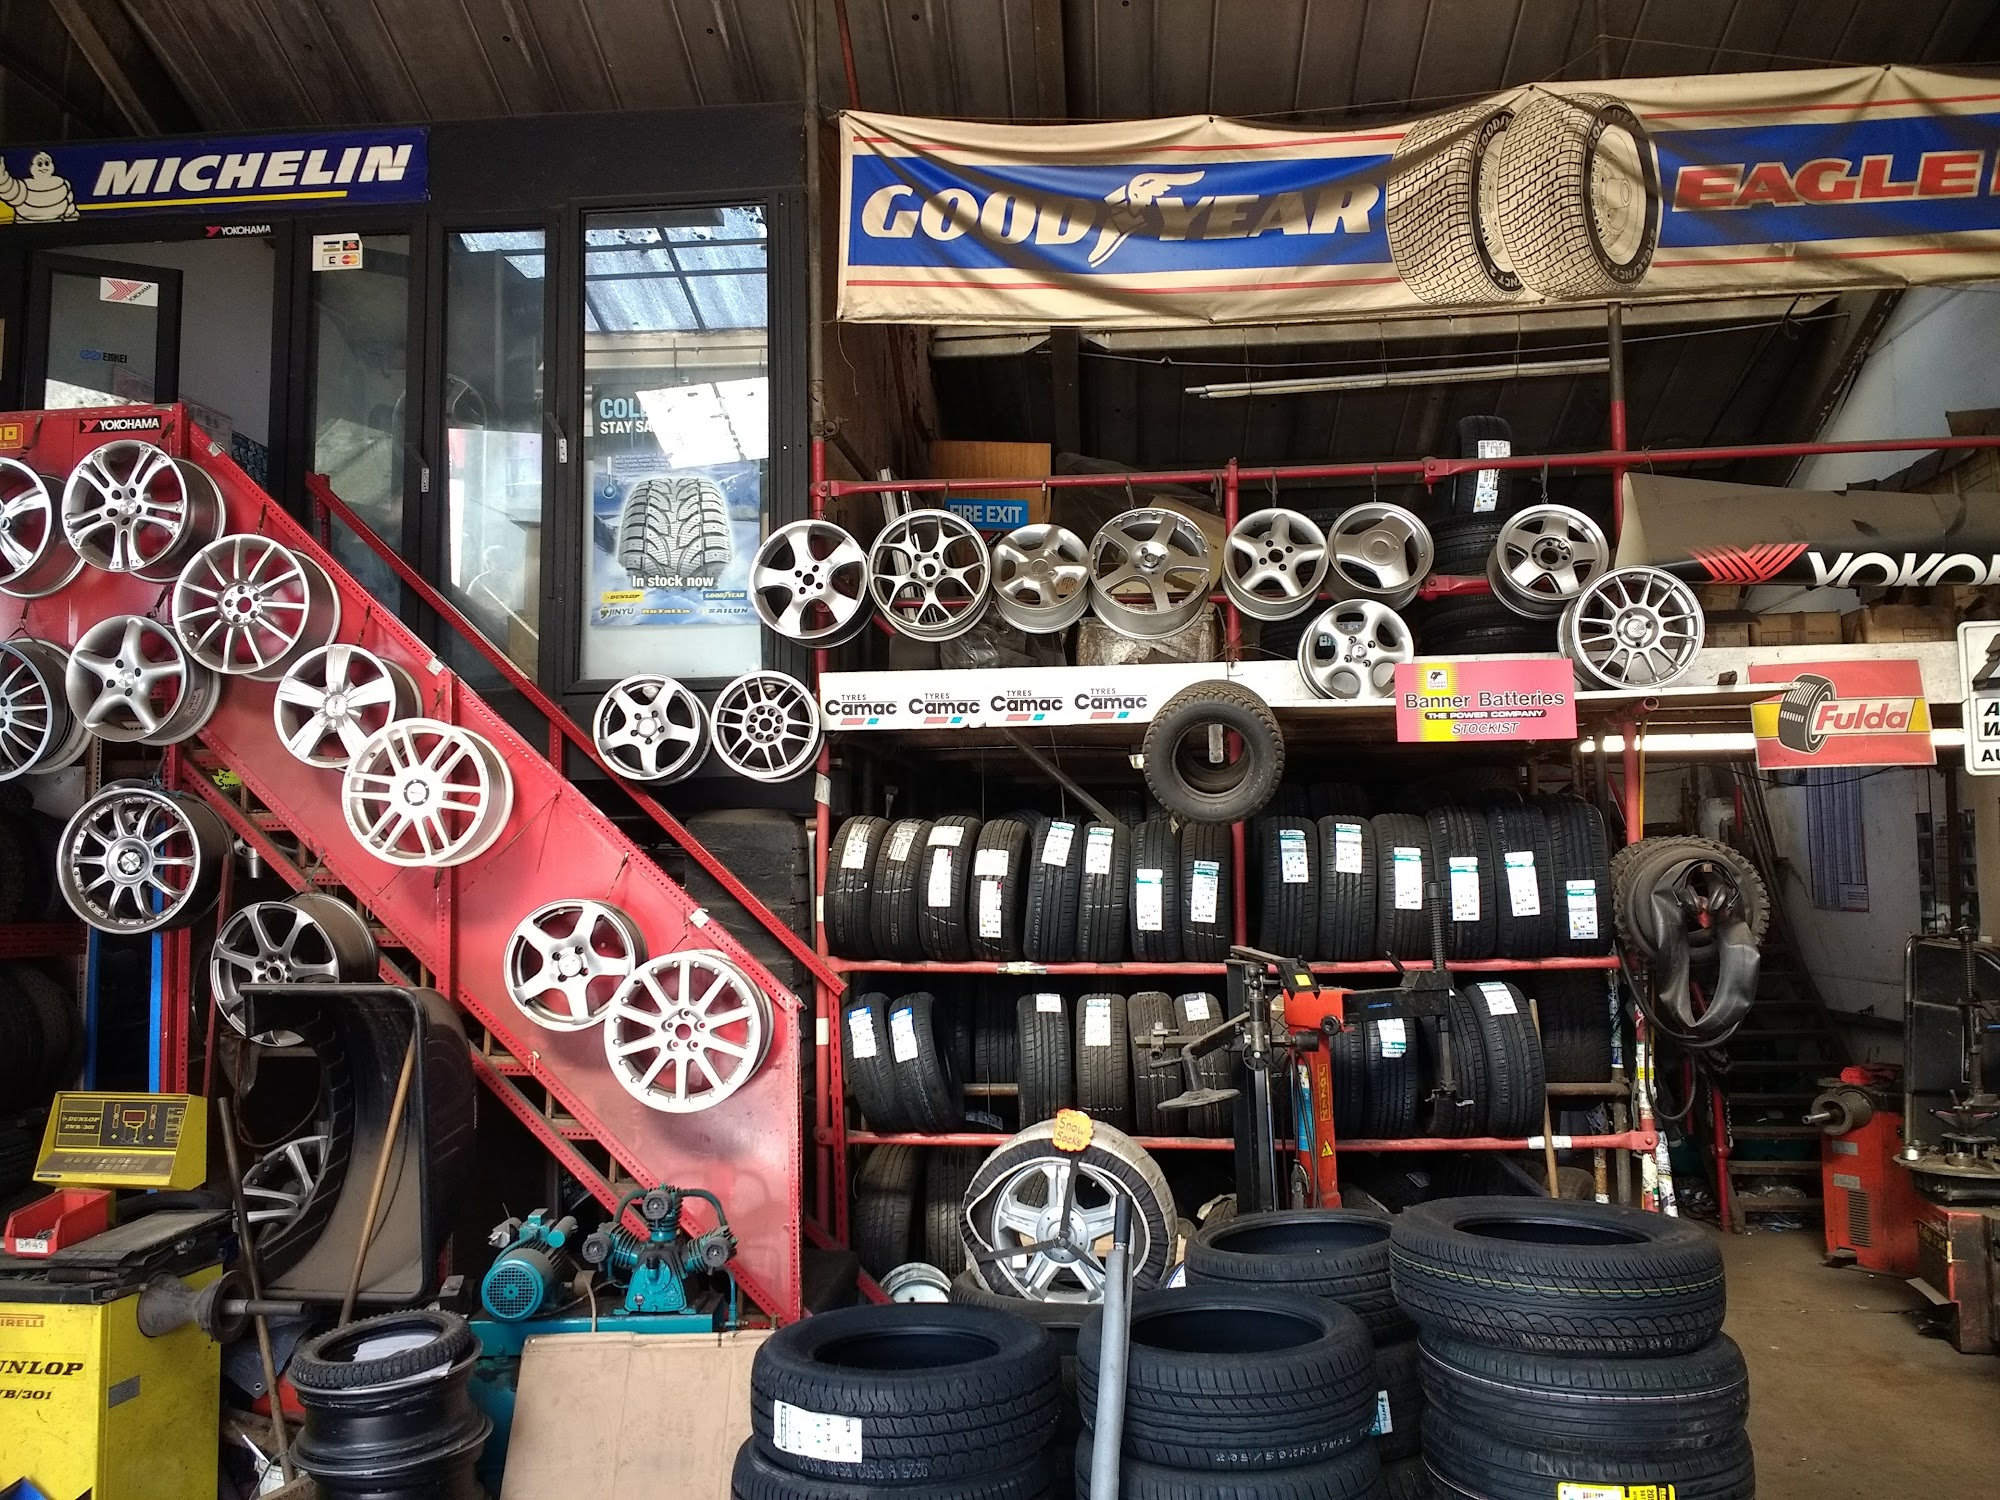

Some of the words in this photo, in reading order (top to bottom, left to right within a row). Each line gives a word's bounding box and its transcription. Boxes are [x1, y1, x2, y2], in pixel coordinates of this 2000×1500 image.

[92, 144, 413, 196] MICHELIN
[1673, 152, 1983, 212] EAGLE
[861, 181, 1380, 246] GOODYEAR
[221, 225, 272, 236] YOKOHAMA
[127, 284, 153, 302] YOKOHAMA
[100, 417, 160, 431] YOKOHAMA
[600, 420, 632, 435] STAY
[949, 504, 983, 523] FIRE
[986, 505, 1022, 524] EXIT
[632, 575, 645, 588] In
[647, 575, 684, 588] stock
[686, 577, 714, 588] now
[608, 608, 634, 617] JINYU
[1006, 690, 1032, 698] TYRES
[1090, 688, 1116, 696] TYRES
[1405, 693, 1470, 709] Banner
[1479, 690, 1565, 707] Batteries
[825, 699, 898, 716] Camac
[908, 698, 981, 715] Camac
[990, 695, 1063, 713] Camac
[1074, 693, 1148, 710] Camac
[1815, 703, 1909, 731] Fulda
[1452, 722, 1519, 734] STOCKIST
[1059, 1117, 1087, 1135] Snow
[1056, 1131, 1082, 1147] Socks
